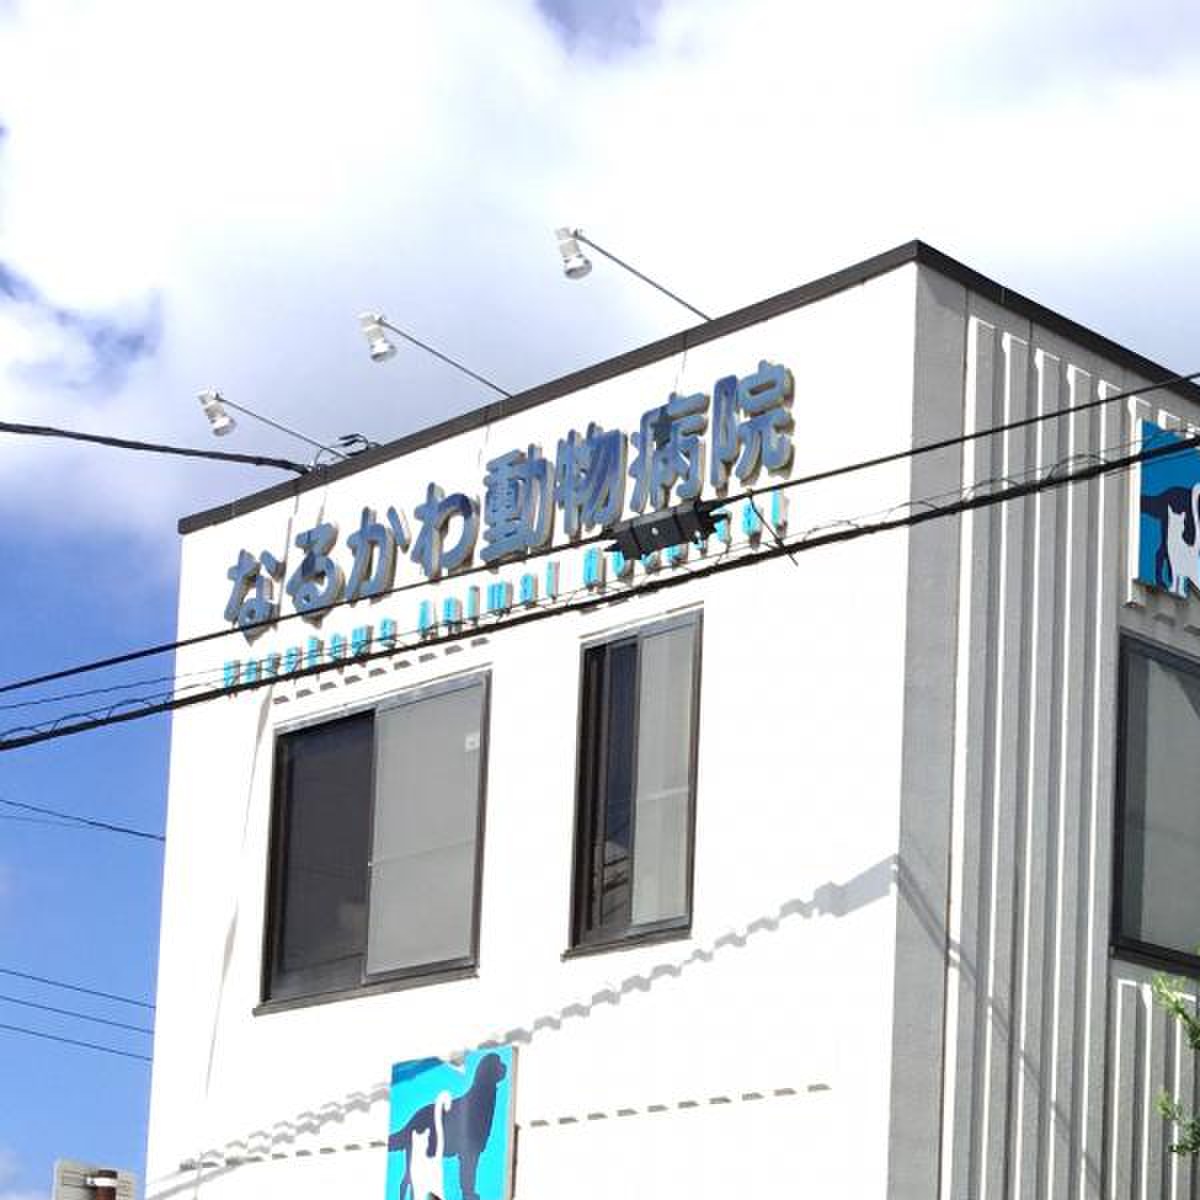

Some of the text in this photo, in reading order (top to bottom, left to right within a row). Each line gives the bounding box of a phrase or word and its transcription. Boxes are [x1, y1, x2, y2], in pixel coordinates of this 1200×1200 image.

[224, 359, 792, 634] なるかわ動物病院
